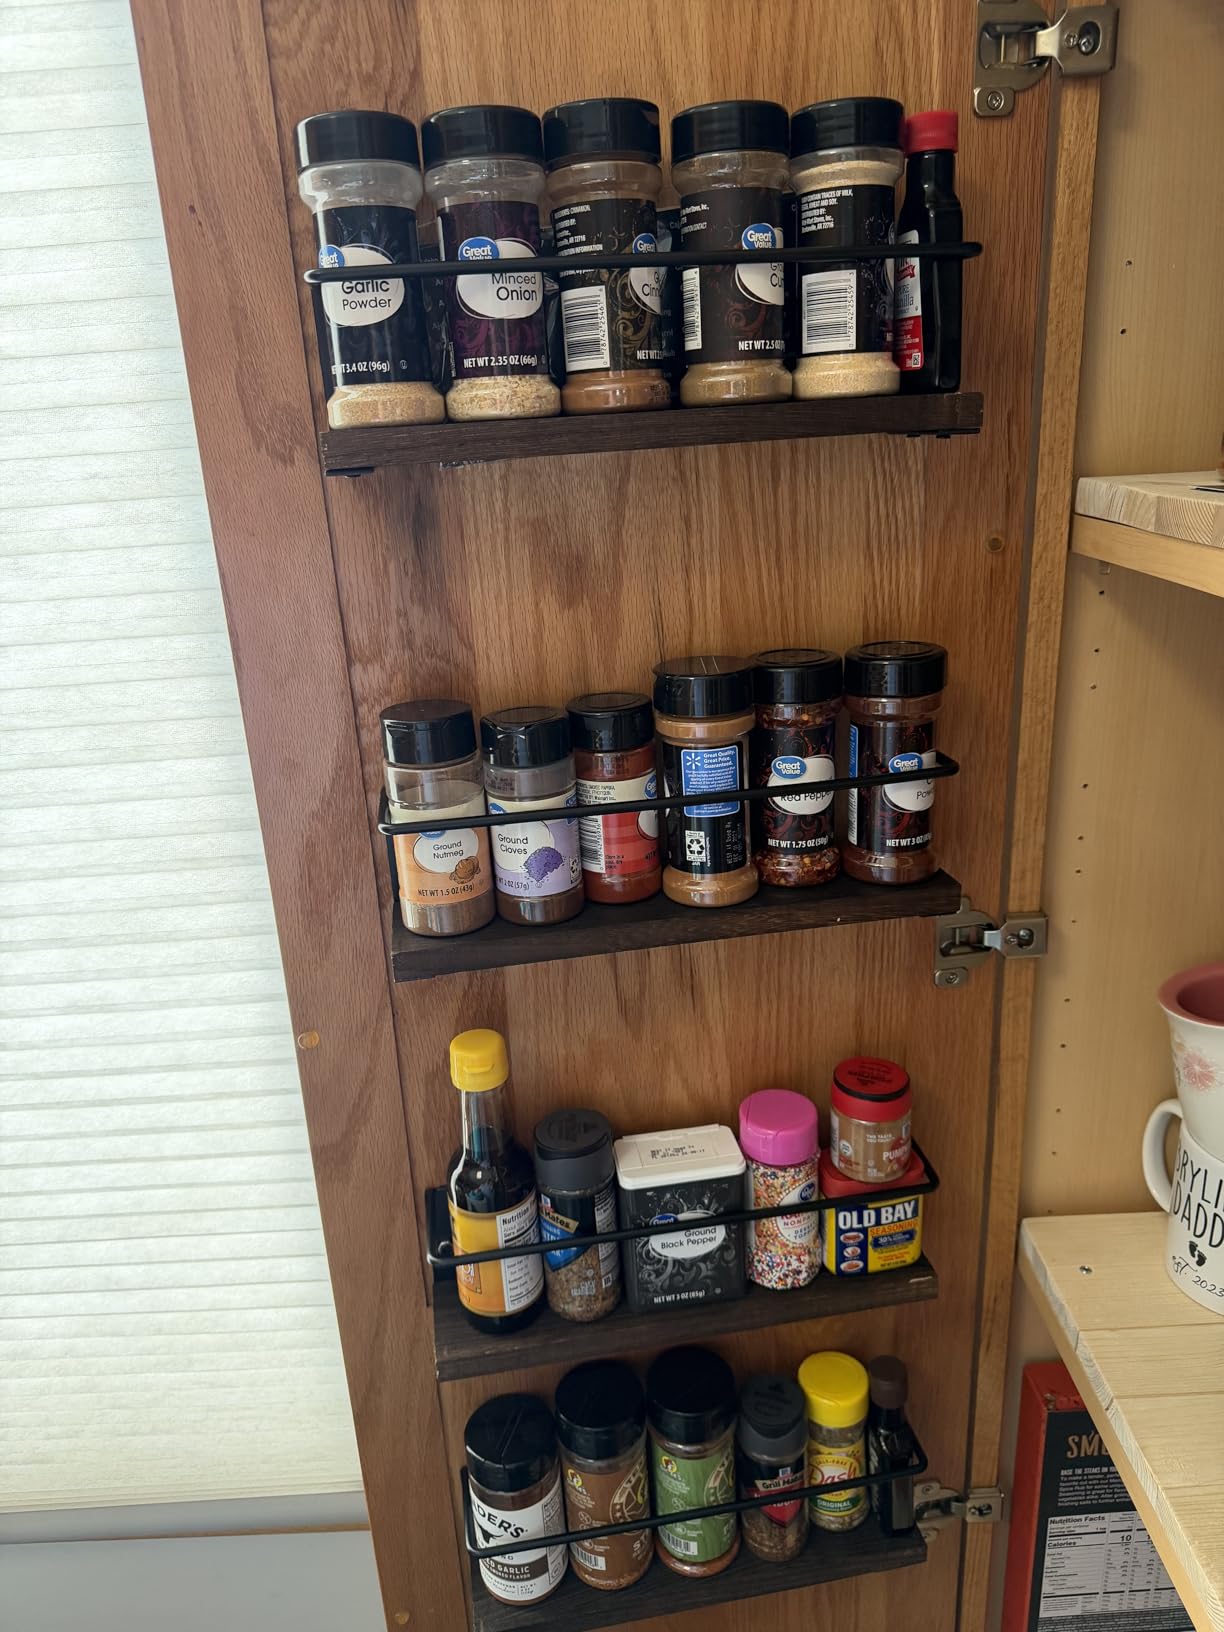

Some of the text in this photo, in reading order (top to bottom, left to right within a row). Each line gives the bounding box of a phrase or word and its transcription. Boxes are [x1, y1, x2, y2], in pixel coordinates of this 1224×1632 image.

[747, 230, 772, 242] Great
[462, 246, 492, 258] Great
[491, 272, 536, 285] Minced
[342, 280, 390, 294] Garlic
[496, 286, 538, 302] Onion
[342, 297, 392, 310] Powder
[738, 341, 752, 350] NET
[754, 340, 764, 350] WT
[636, 350, 649, 360] NET
[358, 362, 368, 372] OZ
[368, 360, 390, 373] (96g)
[464, 354, 538, 368] NET WT 2.35 OZ (66g)
[776, 761, 800, 770] Great
[894, 758, 918, 768] Great
[498, 834, 528, 844] Ground
[768, 838, 780, 846] NET
[780, 840, 790, 848] WT
[792, 840, 806, 848] 1.75
[807, 838, 816, 847] OZ
[912, 838, 916, 846] 3
[433, 841, 462, 851] Ground
[500, 844, 528, 855] Cloves
[434, 850, 464, 860] Nutmeg
[514, 880, 530, 890] (57g)
[418, 888, 428, 897] NET
[450, 886, 460, 895] OZ
[502, 1207, 530, 1226] Nutrition
[881, 1200, 916, 1225] BAY
[838, 1210, 876, 1230] OLD
[684, 1226, 717, 1238] Ground
[870, 1219, 919, 1236] SEASONING
[661, 1236, 717, 1250] Black Pepper
[1192, 1274, 1224, 1298] 2023
[654, 1294, 665, 1304] NET
[666, 1294, 676, 1302] WT
[762, 1481, 781, 1490] Grill
[816, 1500, 850, 1508] ORIGINAL
[1050, 1516, 1082, 1525] Nutrition
[1048, 1540, 1076, 1548] Calories
[498, 1563, 530, 1574] GARLIC
